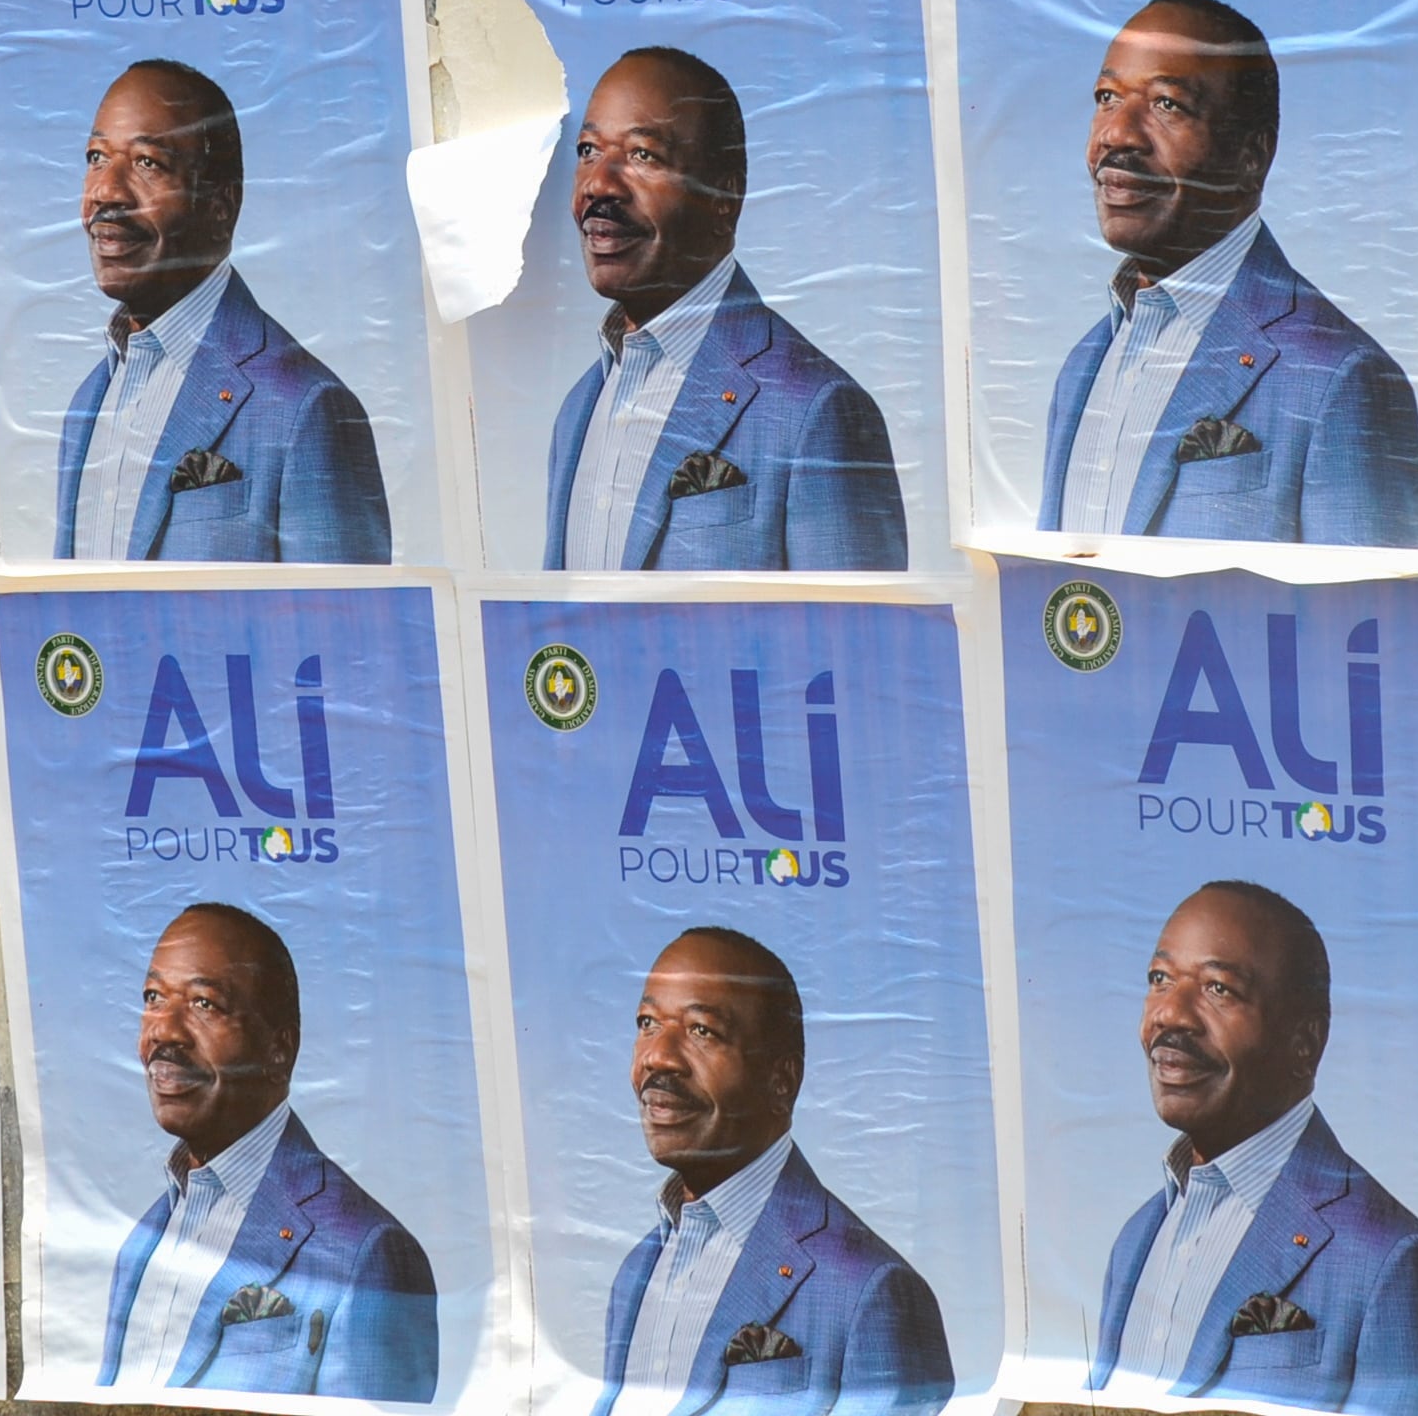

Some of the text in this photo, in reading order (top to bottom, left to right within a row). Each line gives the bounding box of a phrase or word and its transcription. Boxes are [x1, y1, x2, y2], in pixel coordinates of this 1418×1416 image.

[1064, 583, 1091, 595] PARTI
[51, 636, 75, 647] PARTI
[543, 648, 568, 659] PARTI
